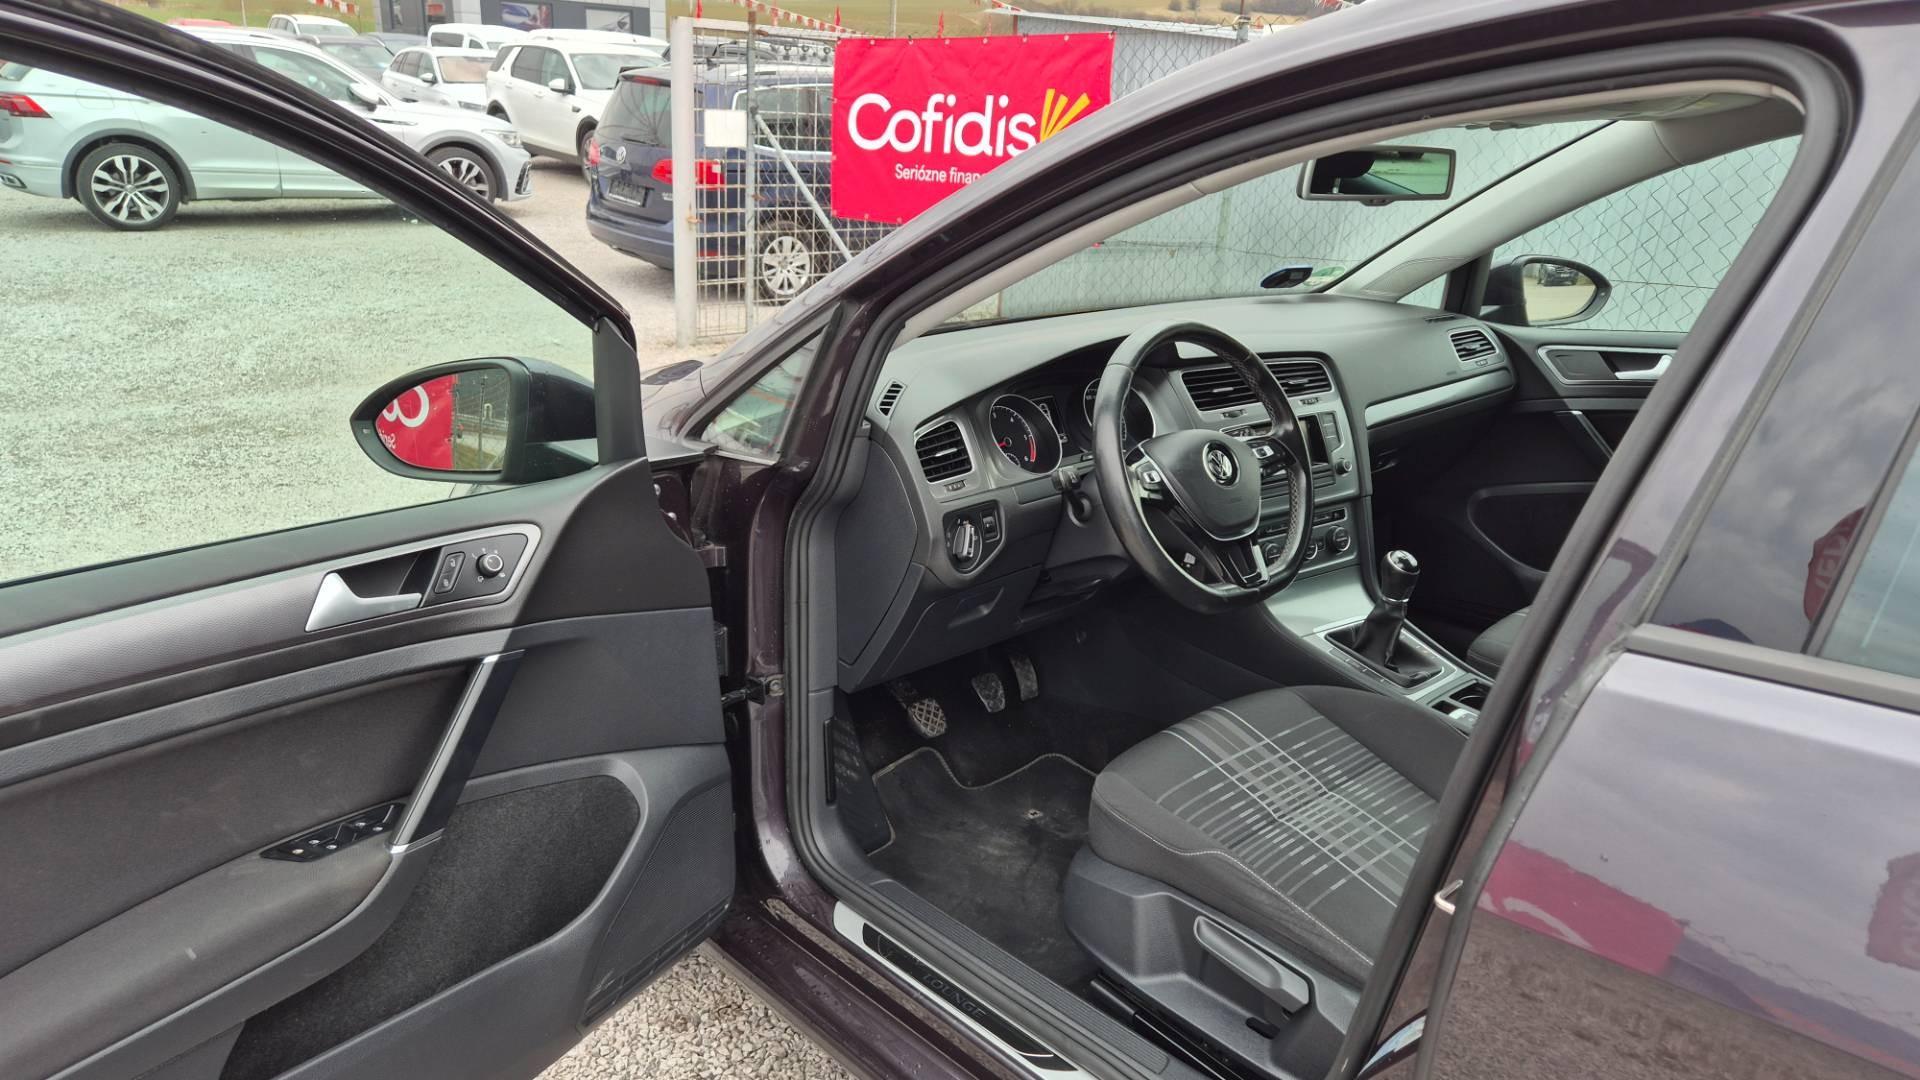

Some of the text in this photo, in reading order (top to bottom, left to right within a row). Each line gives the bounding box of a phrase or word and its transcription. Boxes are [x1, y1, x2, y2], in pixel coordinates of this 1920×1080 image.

[848, 92, 1037, 157] Cofidis
[895, 163, 982, 184] Seriózne finan
[923, 973, 987, 1017] LOUNGE
